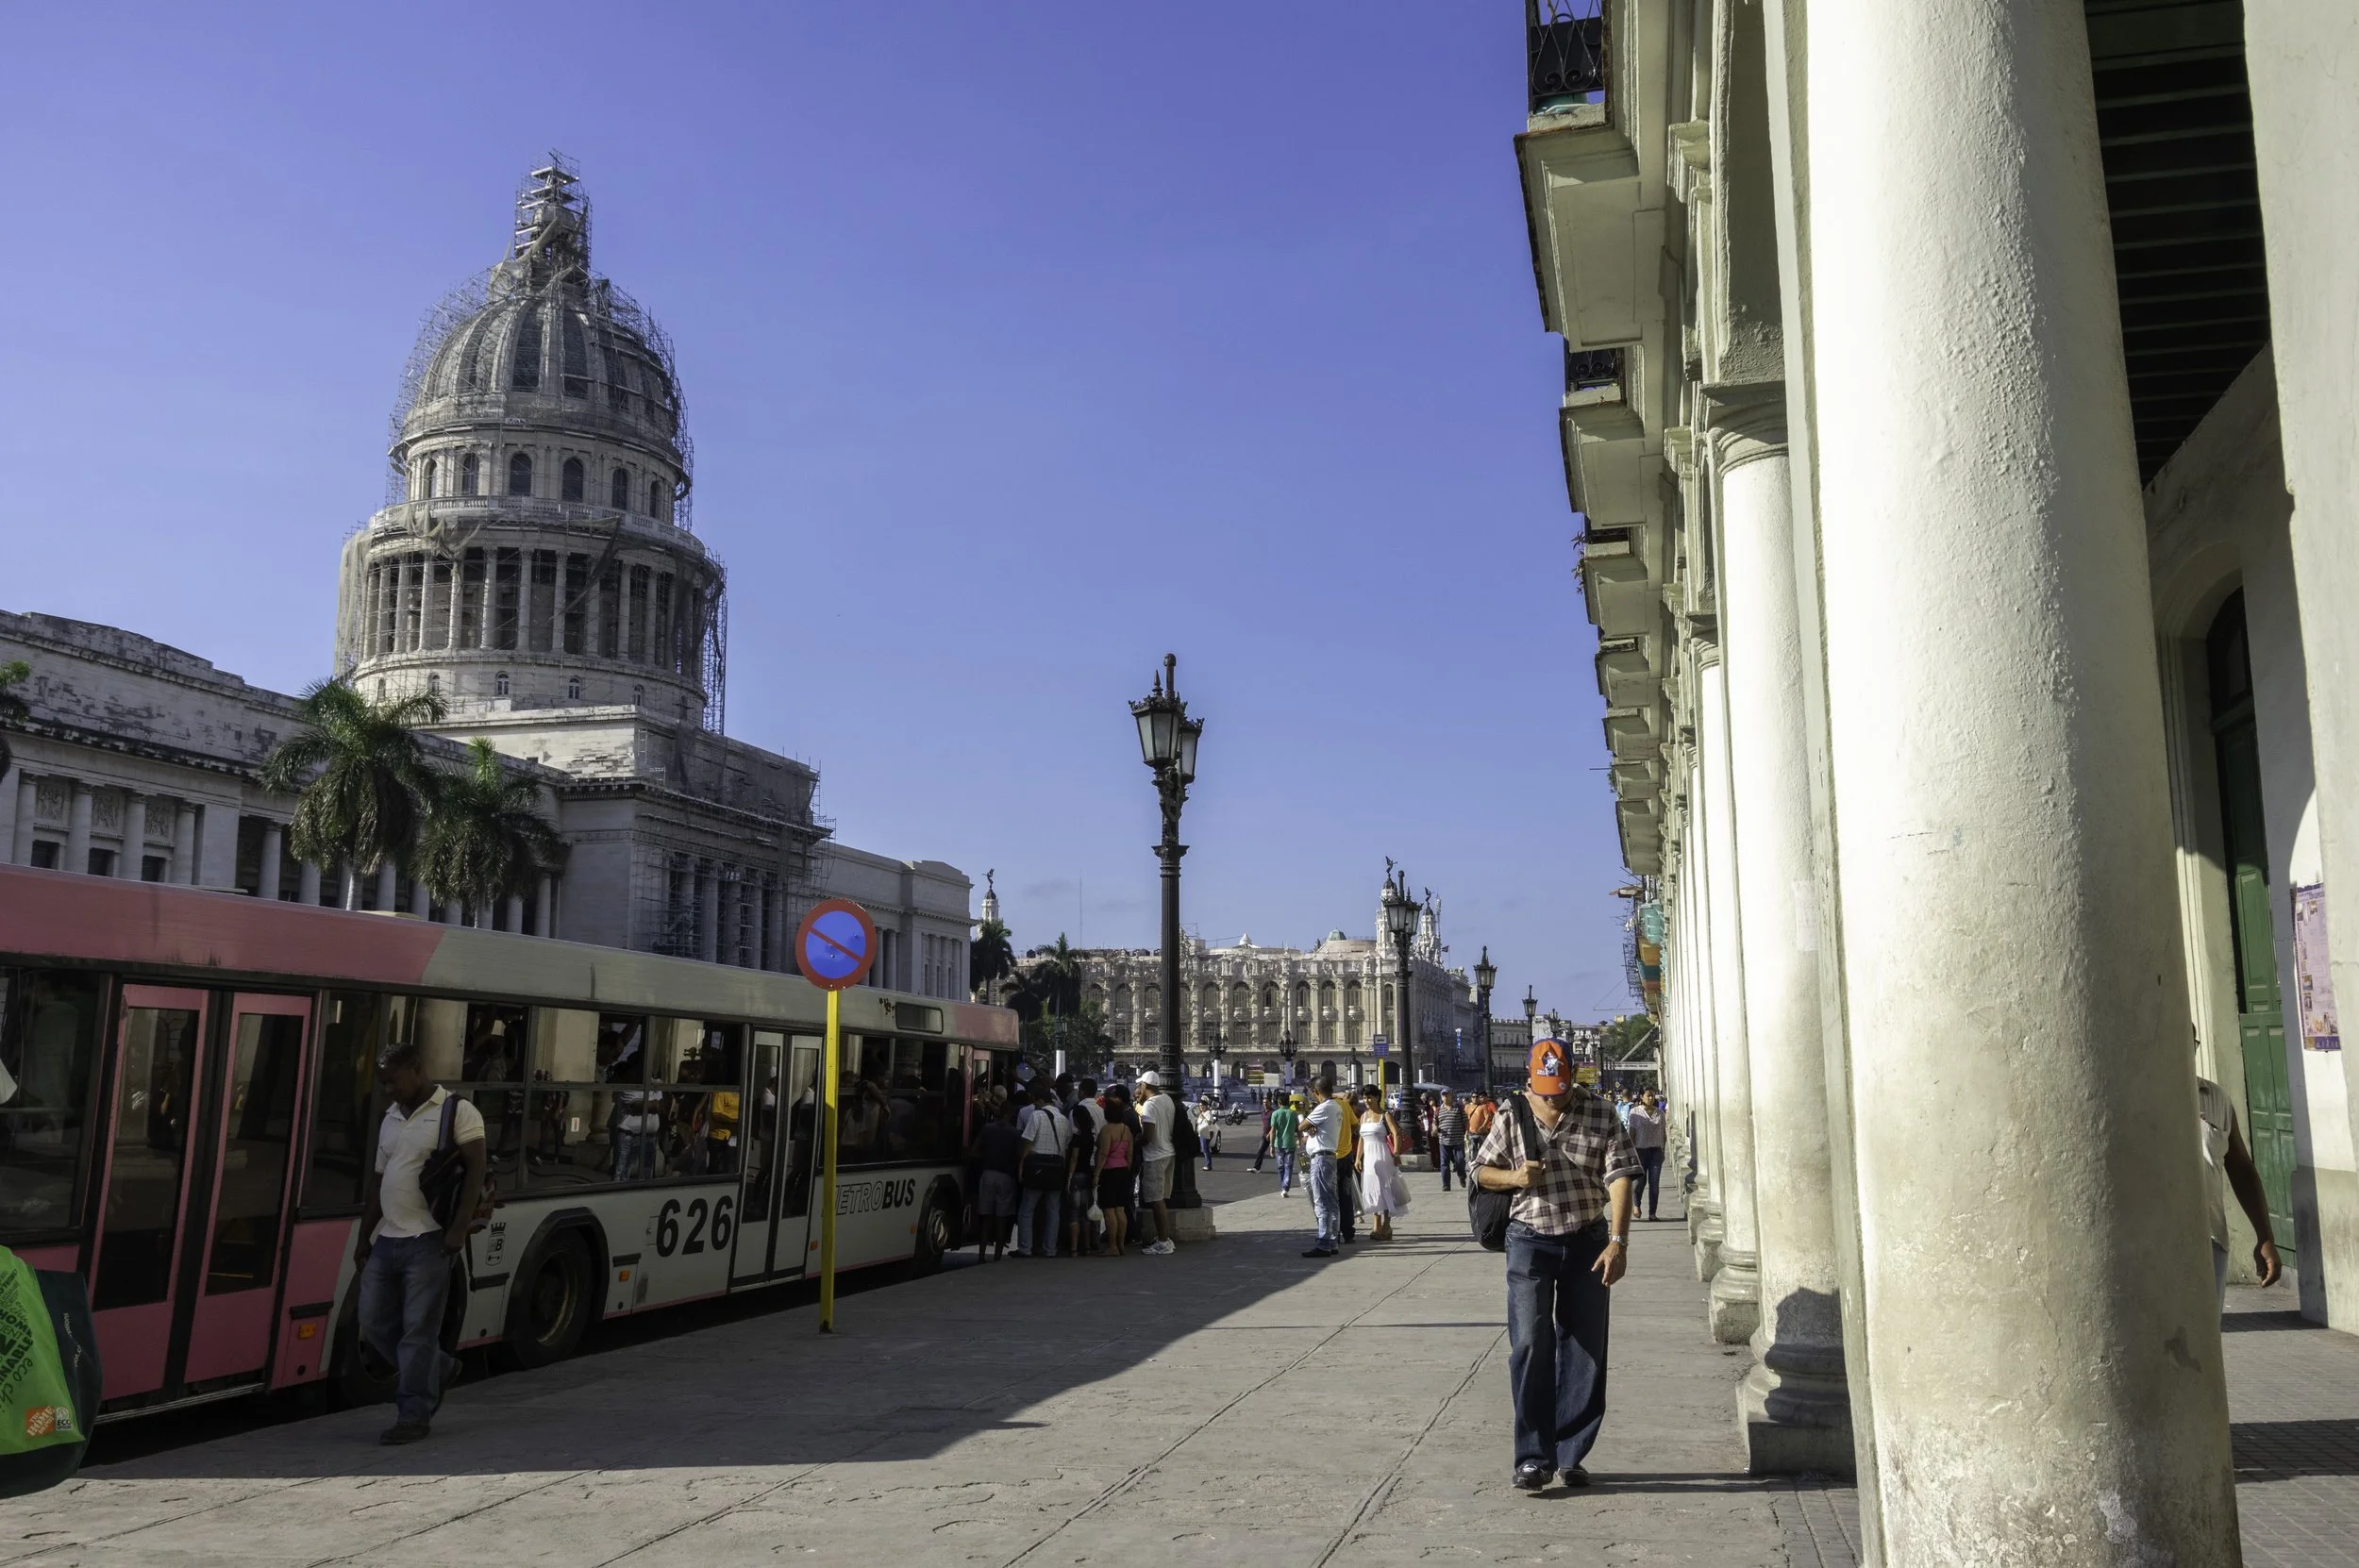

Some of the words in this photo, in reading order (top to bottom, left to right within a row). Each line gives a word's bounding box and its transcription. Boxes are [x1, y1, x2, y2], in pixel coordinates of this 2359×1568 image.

[836, 1178, 915, 1215] ETROBUS
[657, 1195, 733, 1258] 626
[13, 1358, 33, 1381] eco
[27, 1406, 55, 1436] HOME
